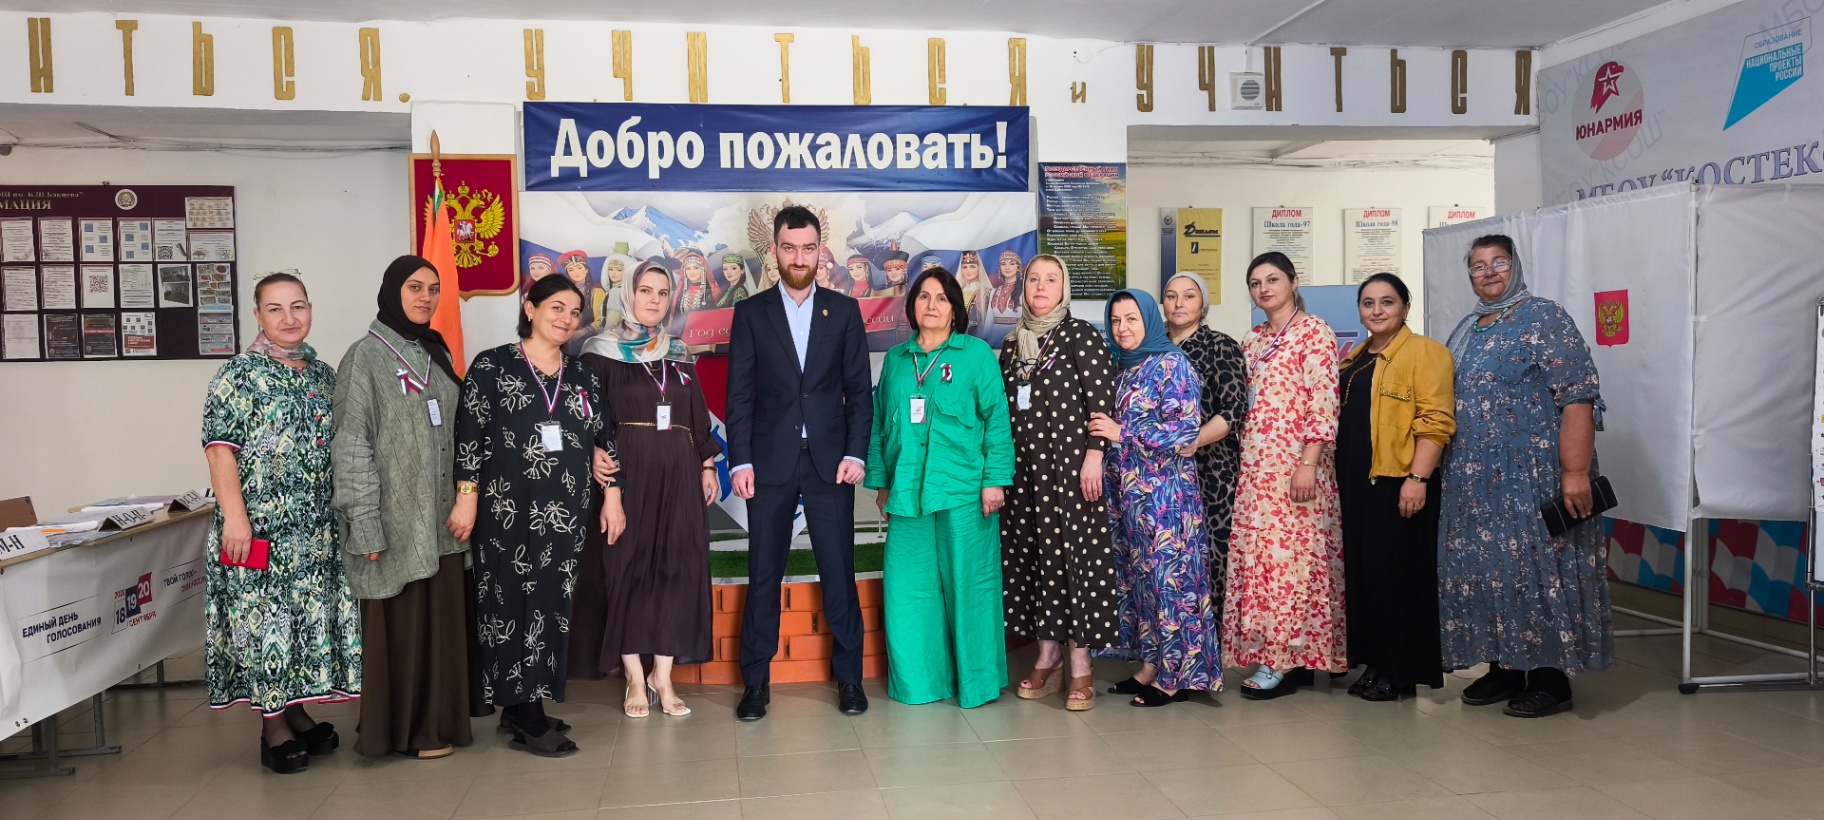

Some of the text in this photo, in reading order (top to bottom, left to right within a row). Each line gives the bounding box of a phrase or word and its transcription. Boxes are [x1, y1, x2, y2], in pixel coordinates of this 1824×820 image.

[1754, 28, 1802, 49] ОБРАЗОВАНИЕ
[1746, 44, 1802, 69] НАЦИОНАЛЬНЫЕ
[1769, 54, 1802, 73] ПРОЕКТЫ
[523, 28, 1027, 106] УЧИТЬСЯ
[1136, 44, 1532, 115] УЧИТЬСЯ
[1775, 66, 1802, 82] РОССИИ
[1576, 109, 1642, 141] ЮНАРМИЯ
[550, 116, 1008, 179] Добро пожаловать!
[1272, 209, 1302, 219] ДИПЛОМ
[1363, 209, 1391, 218] ДИПЛОМ
[1448, 210, 1476, 219] ДИПЛОМ
[1263, 220, 1286, 228] Школа
[1355, 220, 1376, 228] Школа
[163, 573, 179, 587] ТВОЙ
[138, 580, 150, 599] 20
[127, 593, 137, 611] 19
[22, 612, 79, 638] ЕДИНЫЙ ДЕНЬ
[115, 607, 126, 625] 18
[46, 616, 102, 643] ГОЛОСОВАНИЯ
